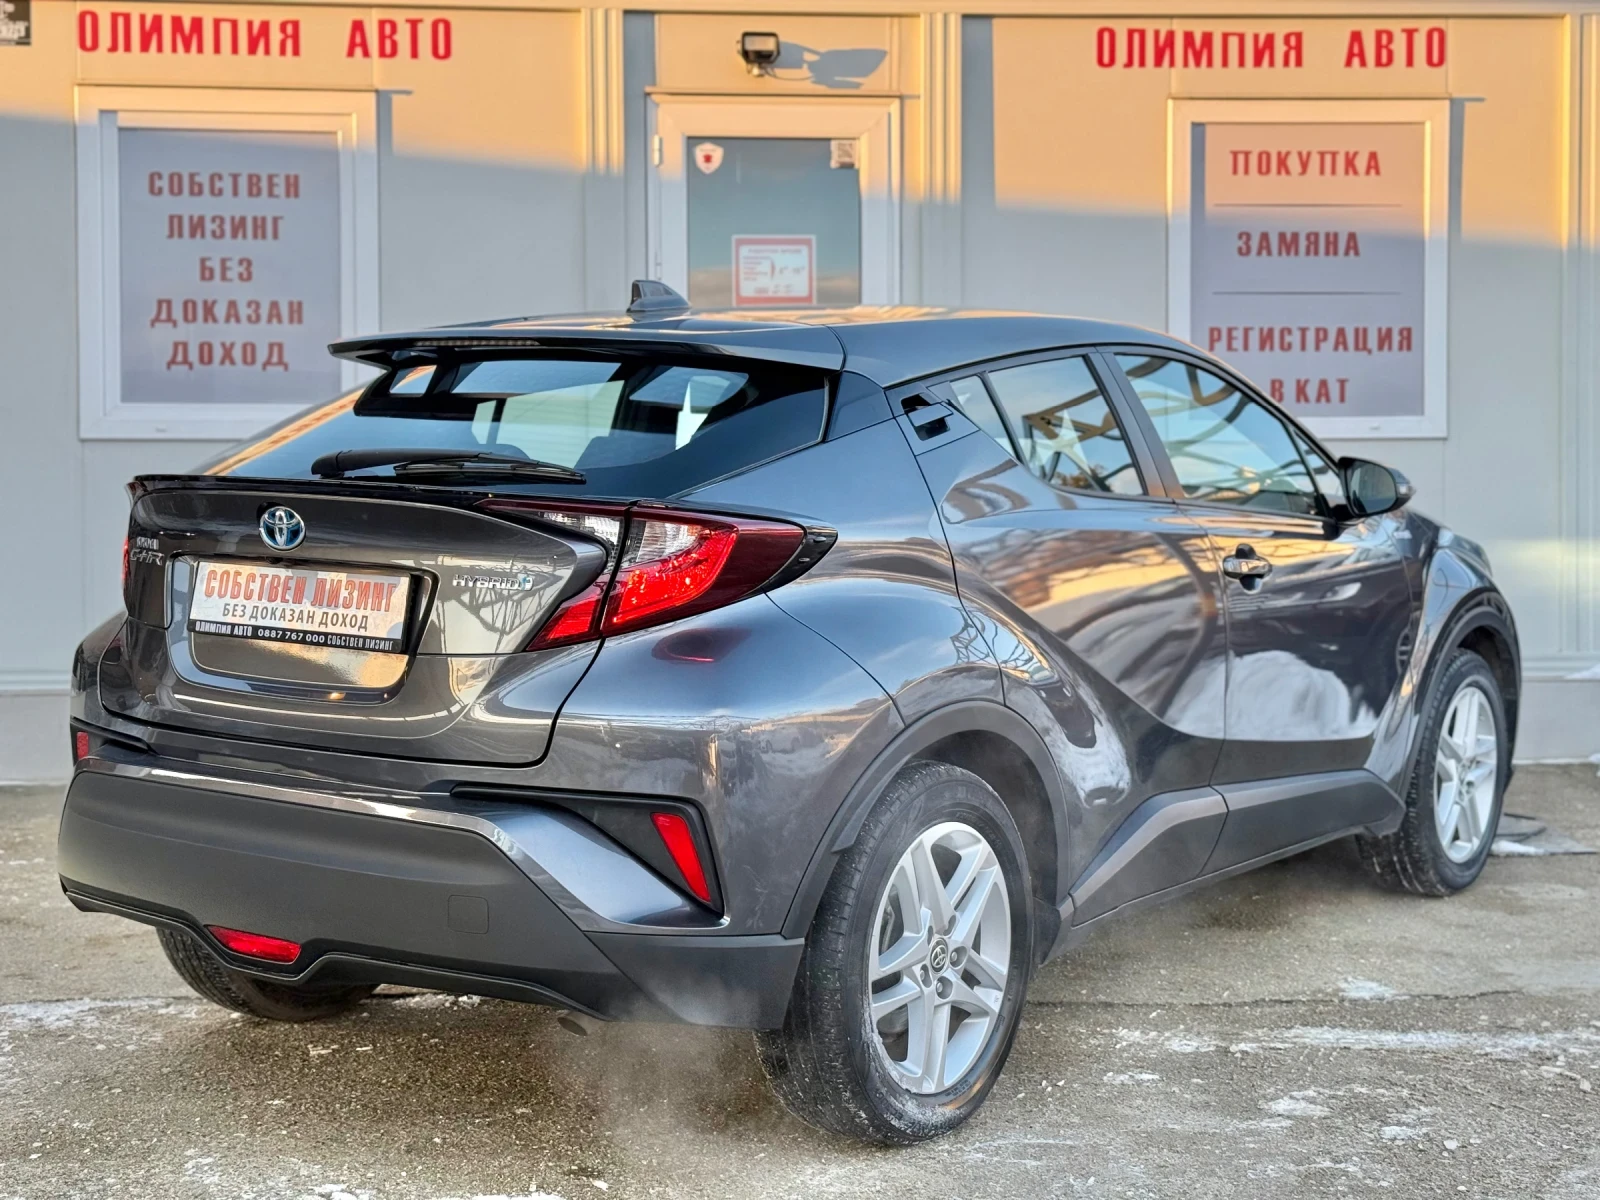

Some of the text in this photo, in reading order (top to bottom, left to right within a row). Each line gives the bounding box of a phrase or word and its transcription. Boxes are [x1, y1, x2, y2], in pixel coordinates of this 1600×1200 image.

[77, 10, 301, 57] ОЛИМПИЯ
[346, 18, 453, 60] АВТО
[1096, 27, 1446, 69] ОЛИМПИЯ АВТО
[1229, 150, 1381, 177] ПОКУПКА
[148, 171, 301, 199] СОБСТВЕН
[166, 214, 284, 241] ЛИЗИНГ
[1237, 231, 1361, 257] ЗАМЯНА
[198, 257, 254, 282] БЕЗ
[150, 298, 304, 328] ДОКАЗАН
[1208, 326, 1413, 355] РЕГИСТРАЦИЯ
[166, 341, 289, 371] ДОХОД
[1295, 378, 1350, 404] КАТ
[204, 569, 397, 612] СОБСТВЕН ЛИЗИНГ
[452, 573, 520, 590] HYBRID
[222, 602, 369, 632] БЕЗ ДОКАЗАН ДОХОД
[195, 620, 394, 651] ОЛИМПИЯ АВТО 0887 767 000 СОБСТВЕН ЛИЗИНГ
